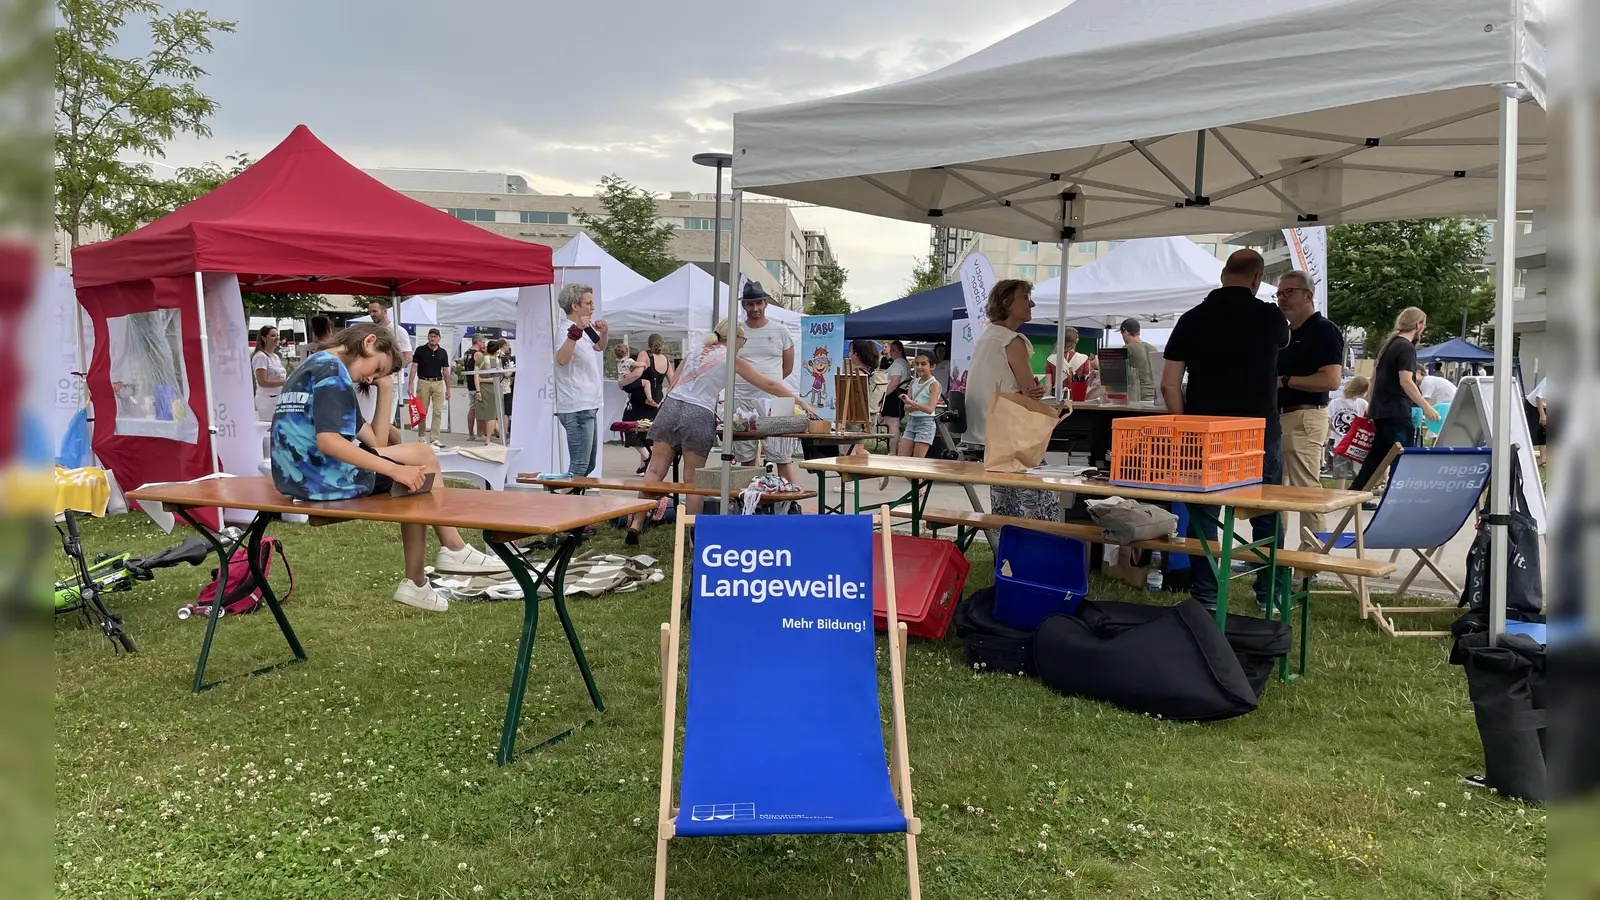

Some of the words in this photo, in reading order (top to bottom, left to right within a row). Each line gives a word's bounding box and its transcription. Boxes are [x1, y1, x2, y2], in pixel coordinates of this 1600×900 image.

[810, 321, 834, 336] KABU
[702, 544, 792, 573] Gegen
[700, 574, 866, 603] Langeweile:
[782, 618, 814, 629] Mehr
[817, 618, 866, 633] Bildung!
